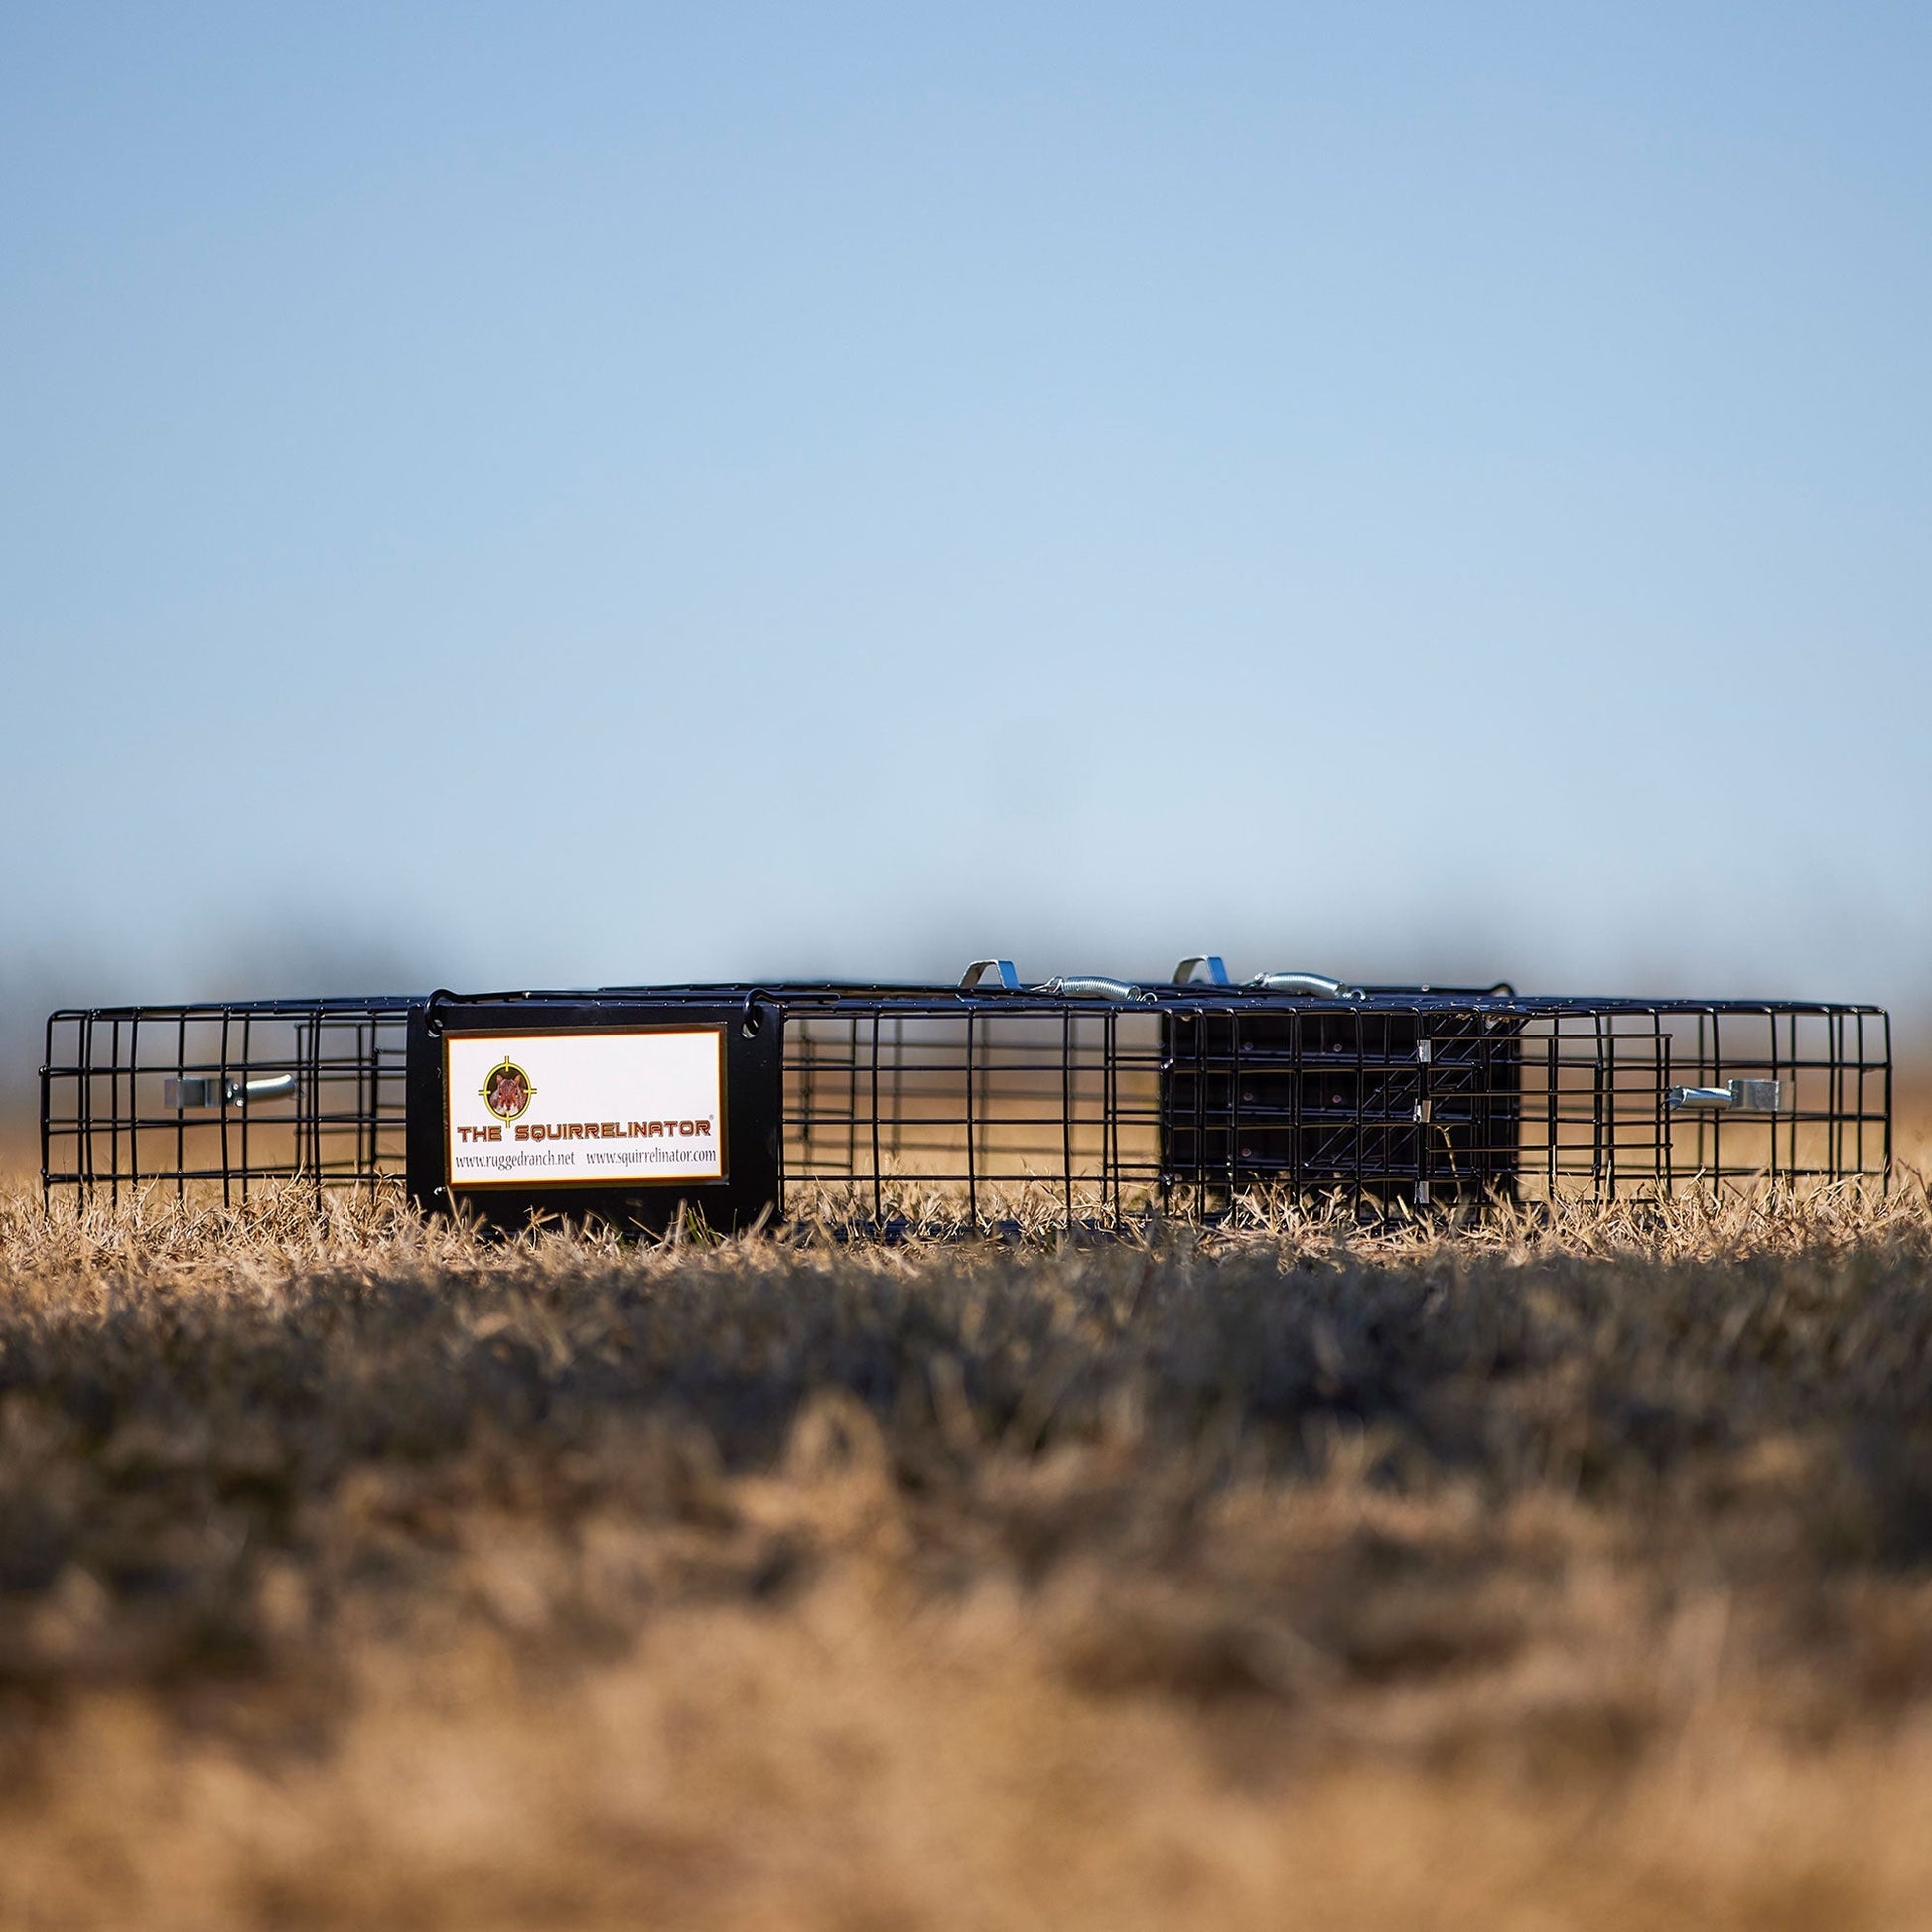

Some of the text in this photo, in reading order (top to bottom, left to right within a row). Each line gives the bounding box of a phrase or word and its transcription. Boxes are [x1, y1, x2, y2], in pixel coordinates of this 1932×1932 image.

[457, 1119, 712, 1143] THE SQUIRRELINATOR
[455, 1147, 717, 1171] www.ruggedranch.net www.squirrelinator.com
